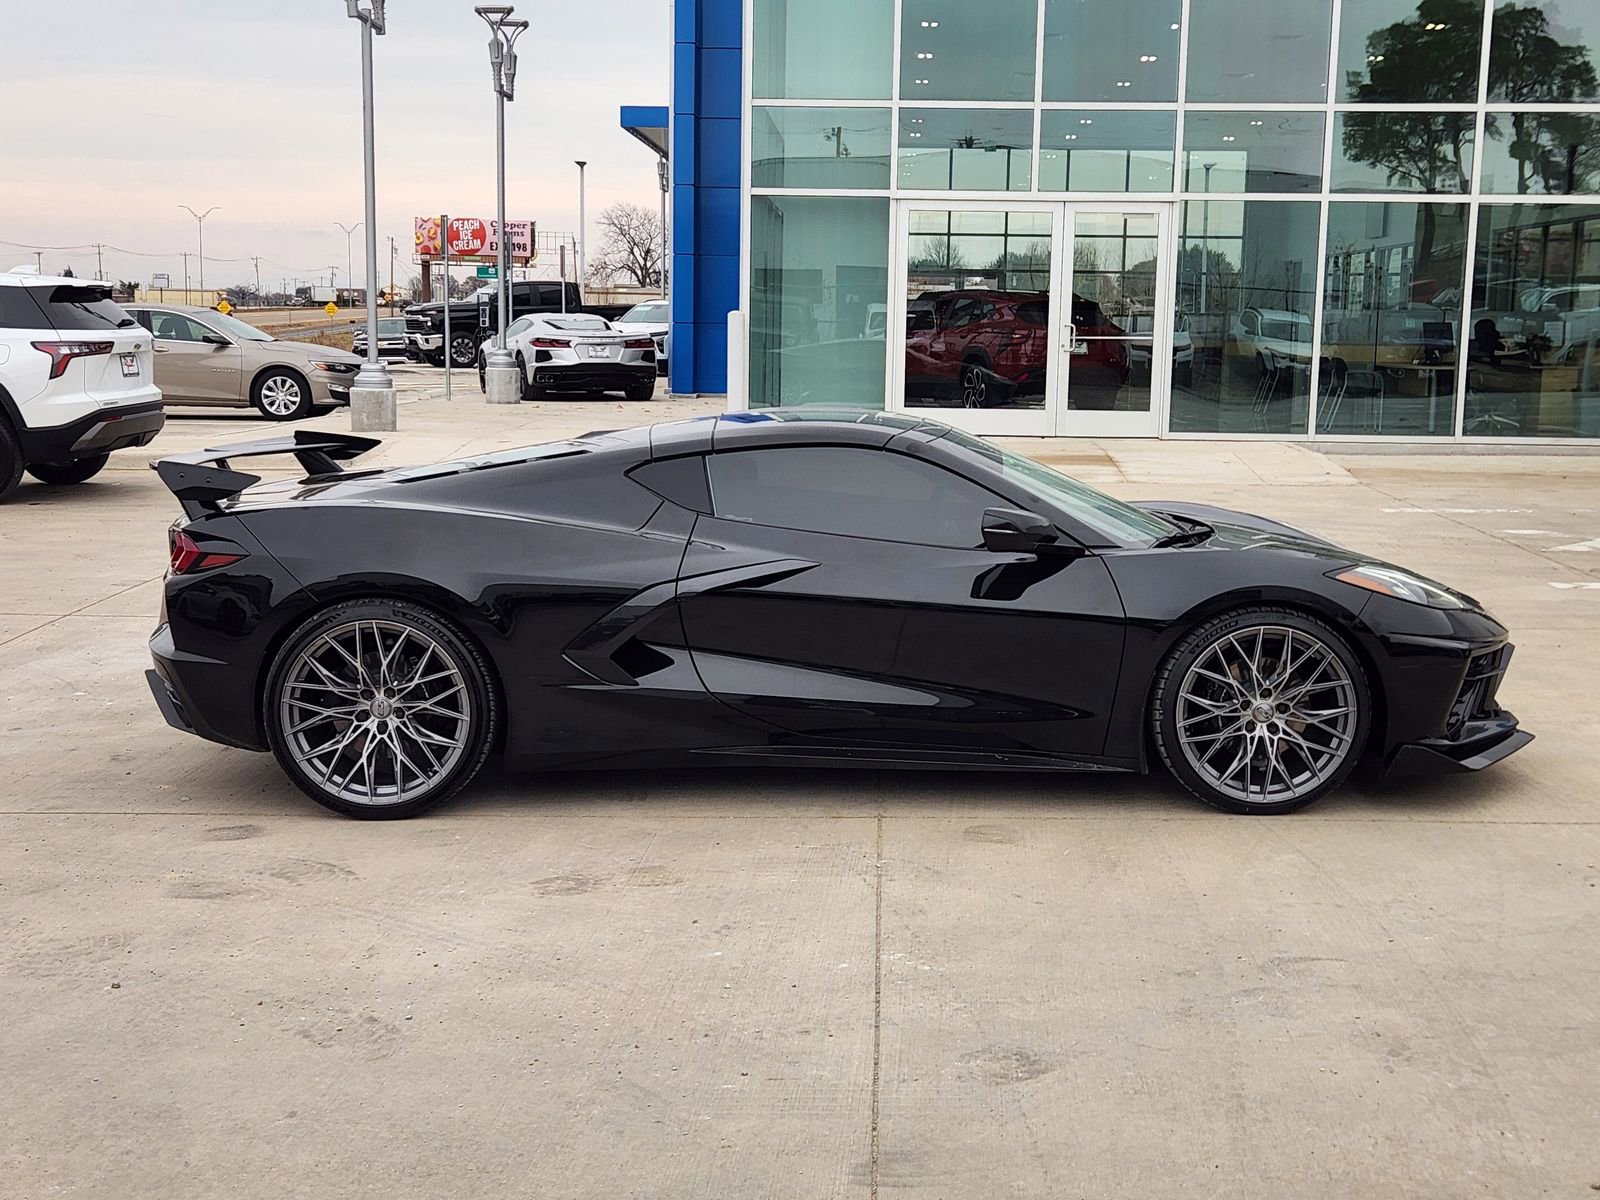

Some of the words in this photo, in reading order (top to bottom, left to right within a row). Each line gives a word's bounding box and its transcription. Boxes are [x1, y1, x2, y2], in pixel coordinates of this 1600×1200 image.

[453, 221, 480, 231] PEACH
[490, 220, 528, 229] Coper
[459, 230, 473, 240] ICE
[453, 239, 481, 251] CREAM
[512, 242, 528, 252] 198
[404, 611, 450, 642] MICHELIN
